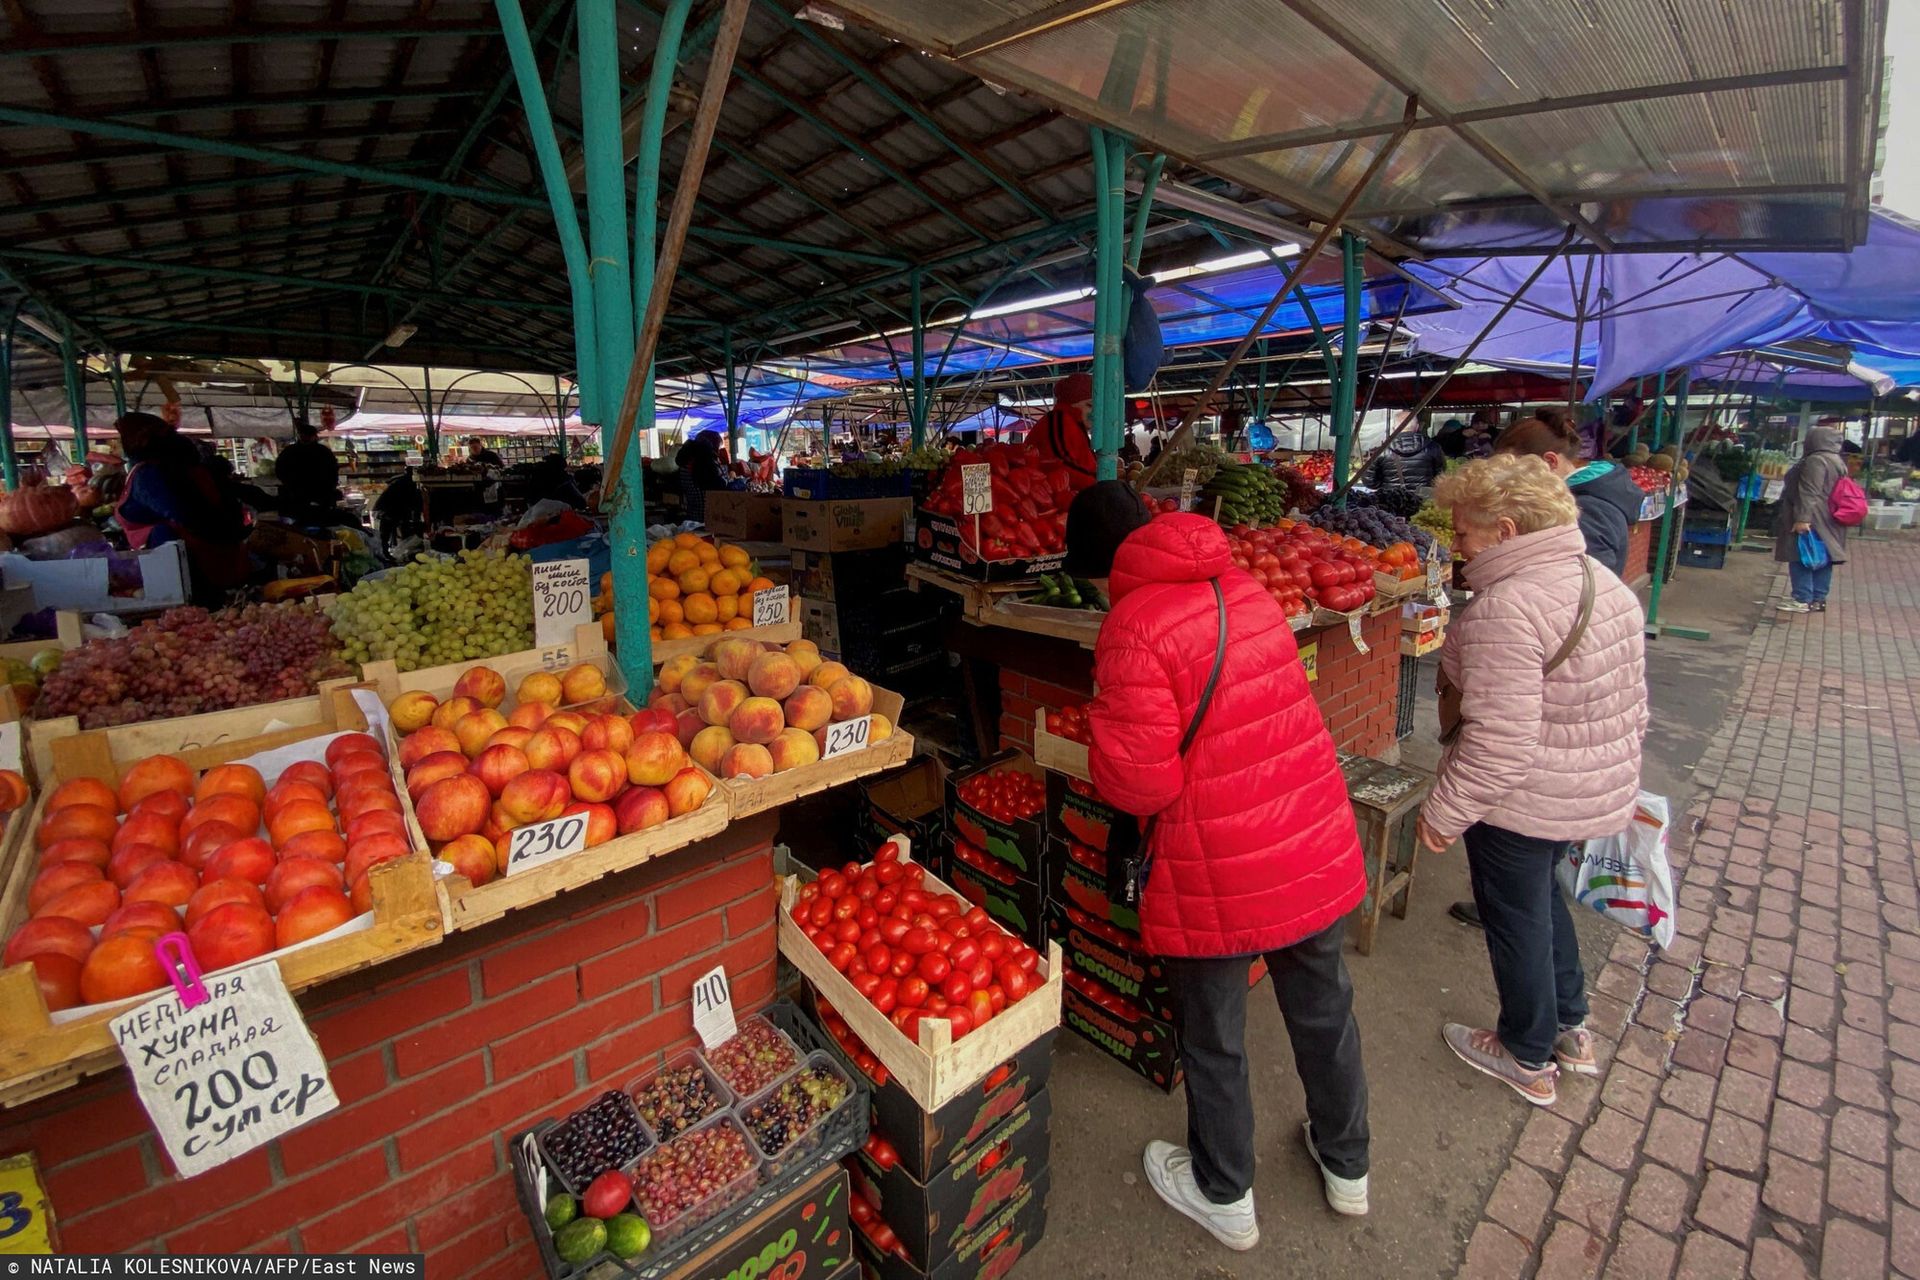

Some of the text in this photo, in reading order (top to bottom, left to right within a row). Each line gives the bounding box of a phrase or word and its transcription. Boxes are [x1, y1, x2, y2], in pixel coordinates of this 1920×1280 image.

[965, 494, 985, 514] 90
[543, 590, 584, 618] 200
[757, 602, 783, 624] 250
[828, 719, 868, 755] 230
[512, 818, 584, 864] 230
[696, 974, 727, 1013] 40
[139, 1005, 238, 1066] ХУРМА
[154, 1017, 283, 1085] СЛАДКАЯ
[175, 1050, 278, 1130] 200
